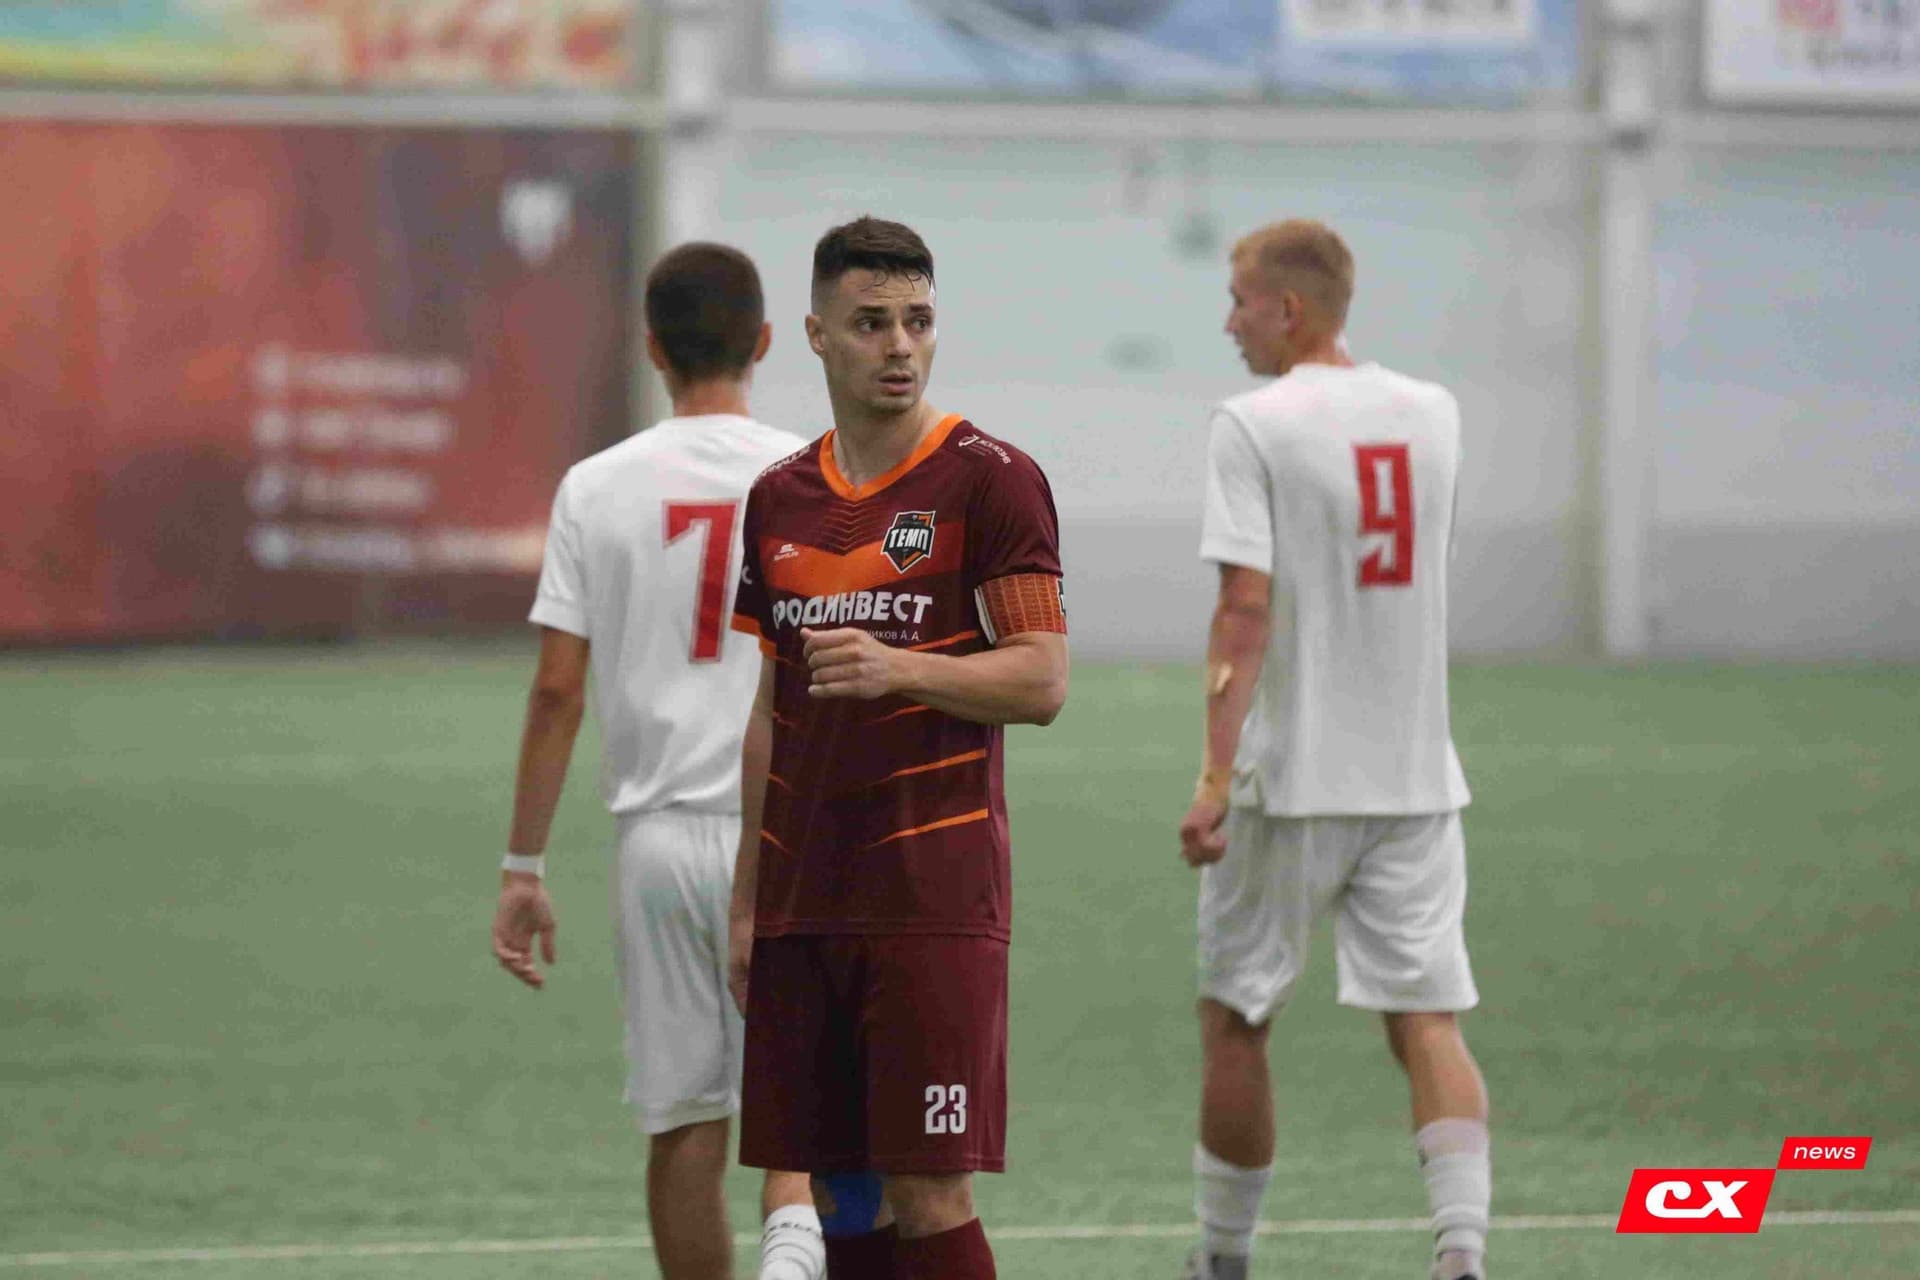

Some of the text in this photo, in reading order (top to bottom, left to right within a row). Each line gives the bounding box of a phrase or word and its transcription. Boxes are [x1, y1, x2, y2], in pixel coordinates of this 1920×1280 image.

[888, 528, 930, 551] ТЕМП
[1352, 444, 1413, 587] 9
[663, 499, 738, 666] 7
[772, 590, 933, 630] РОДИНВЕСТ
[924, 1083, 968, 1134] 23
